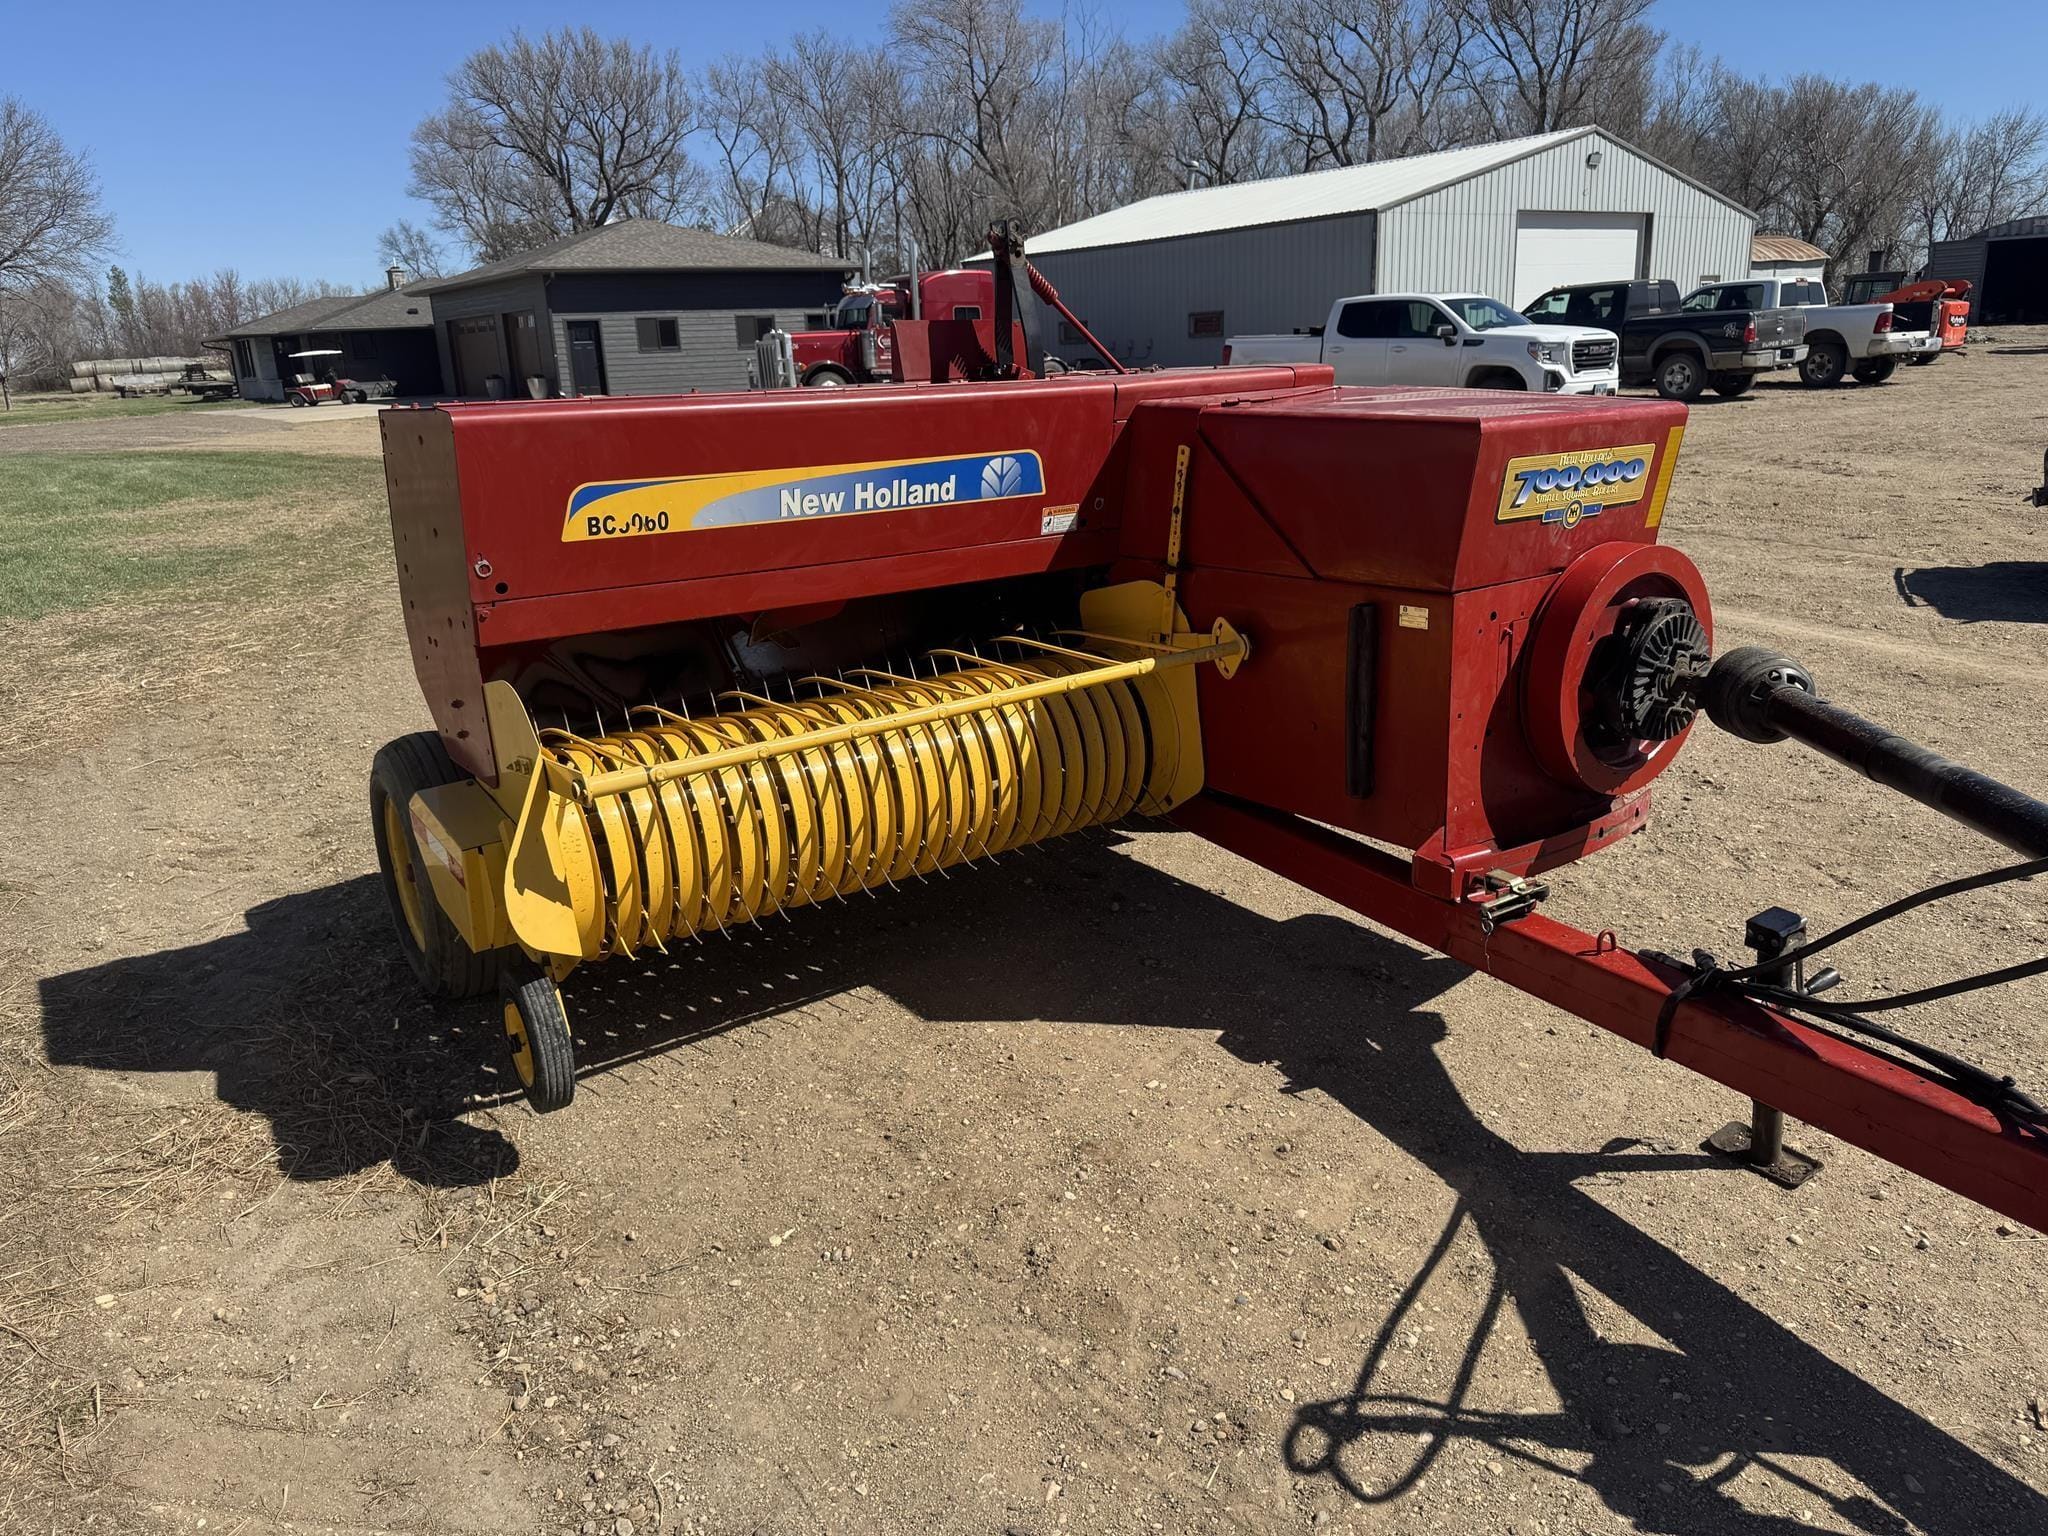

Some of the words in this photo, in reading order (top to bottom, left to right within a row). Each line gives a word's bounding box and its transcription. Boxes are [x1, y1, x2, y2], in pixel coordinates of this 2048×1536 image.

[780, 488, 846, 517] New
[854, 474, 956, 510] Holland
[1510, 457, 1645, 509] 700,000
